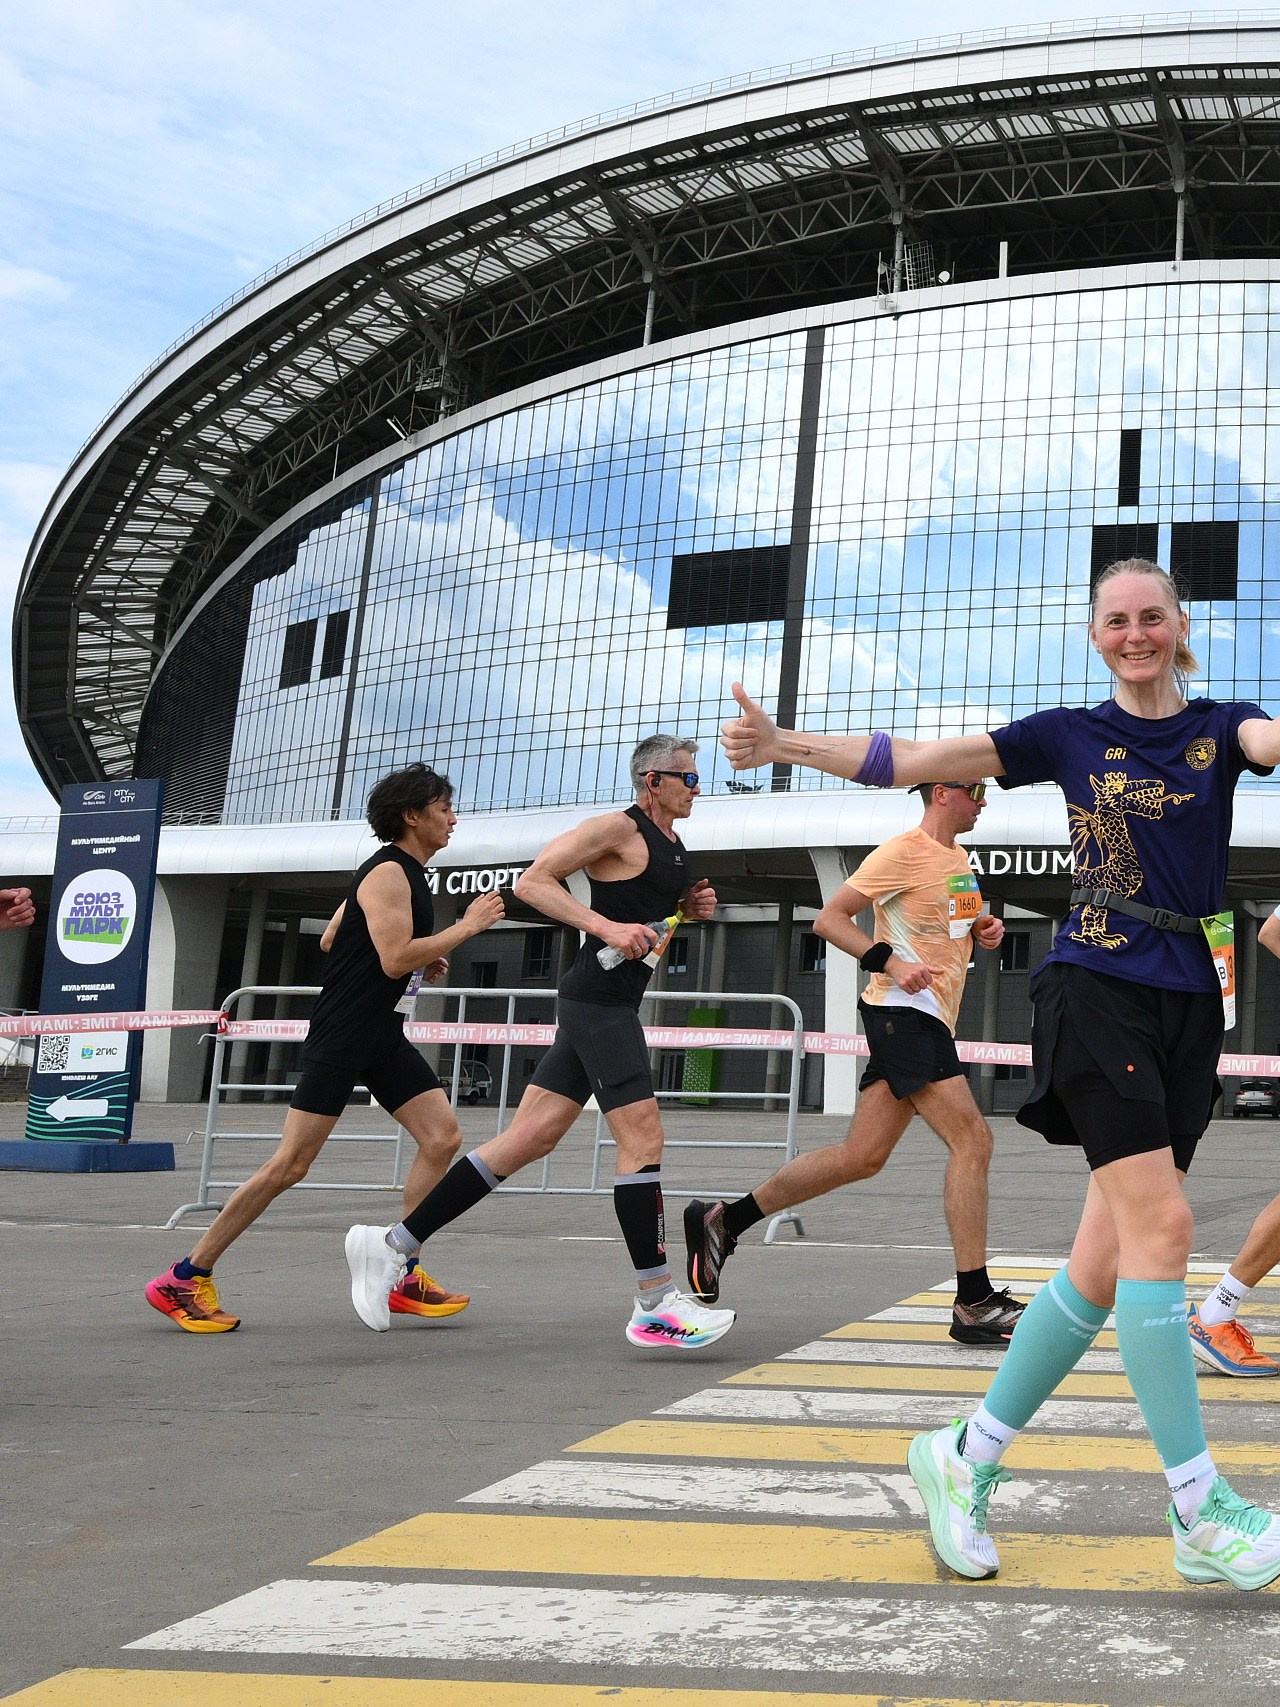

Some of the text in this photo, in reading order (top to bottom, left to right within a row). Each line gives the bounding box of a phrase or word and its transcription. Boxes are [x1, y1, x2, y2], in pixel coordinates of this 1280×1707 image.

[114, 789, 129, 797] CITY
[120, 795, 135, 803] CITY
[92, 847, 117, 855] ЦЕНТР
[967, 850, 1076, 876] ADIUM
[446, 867, 525, 895] СПОРТ
[74, 892, 121, 906] СОЮЗ
[959, 897, 977, 911] 1660
[69, 904, 125, 917] МУЛЬТ
[64, 917, 124, 935] ПАРК
[1218, 966, 1227, 980] B
[96, 1047, 118, 1056] 2ГИС
[1188, 1320, 1213, 1346] HOKA
